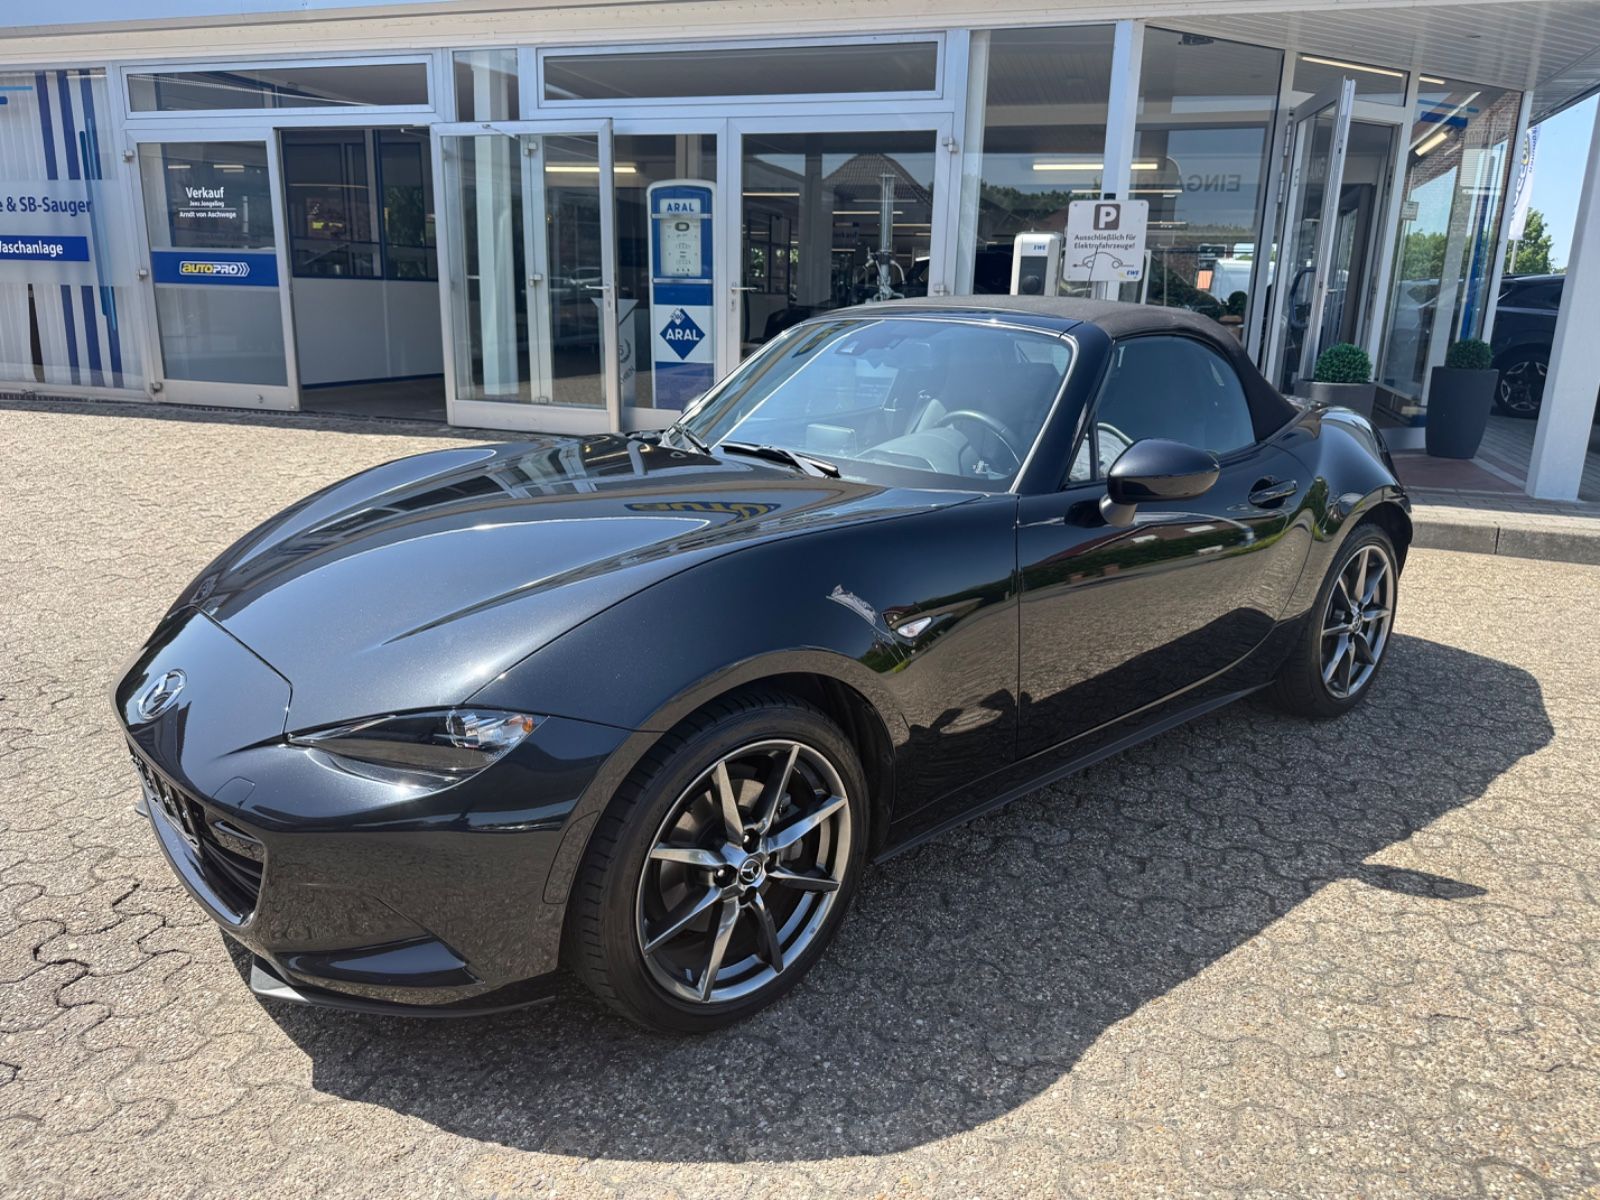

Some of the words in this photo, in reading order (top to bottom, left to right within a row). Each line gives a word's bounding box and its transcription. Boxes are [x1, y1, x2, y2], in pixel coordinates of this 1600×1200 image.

[185, 187, 224, 198] Verkauf
[6, 196, 17, 212] &
[19, 196, 93, 217] SB-Sauger
[667, 202, 695, 212] ARAL
[1098, 206, 1117, 229] P
[1074, 233, 1125, 241] Ausschließlich
[1074, 242, 1136, 250] Elektrofahrzeuge!
[665, 328, 700, 341] ARAL
